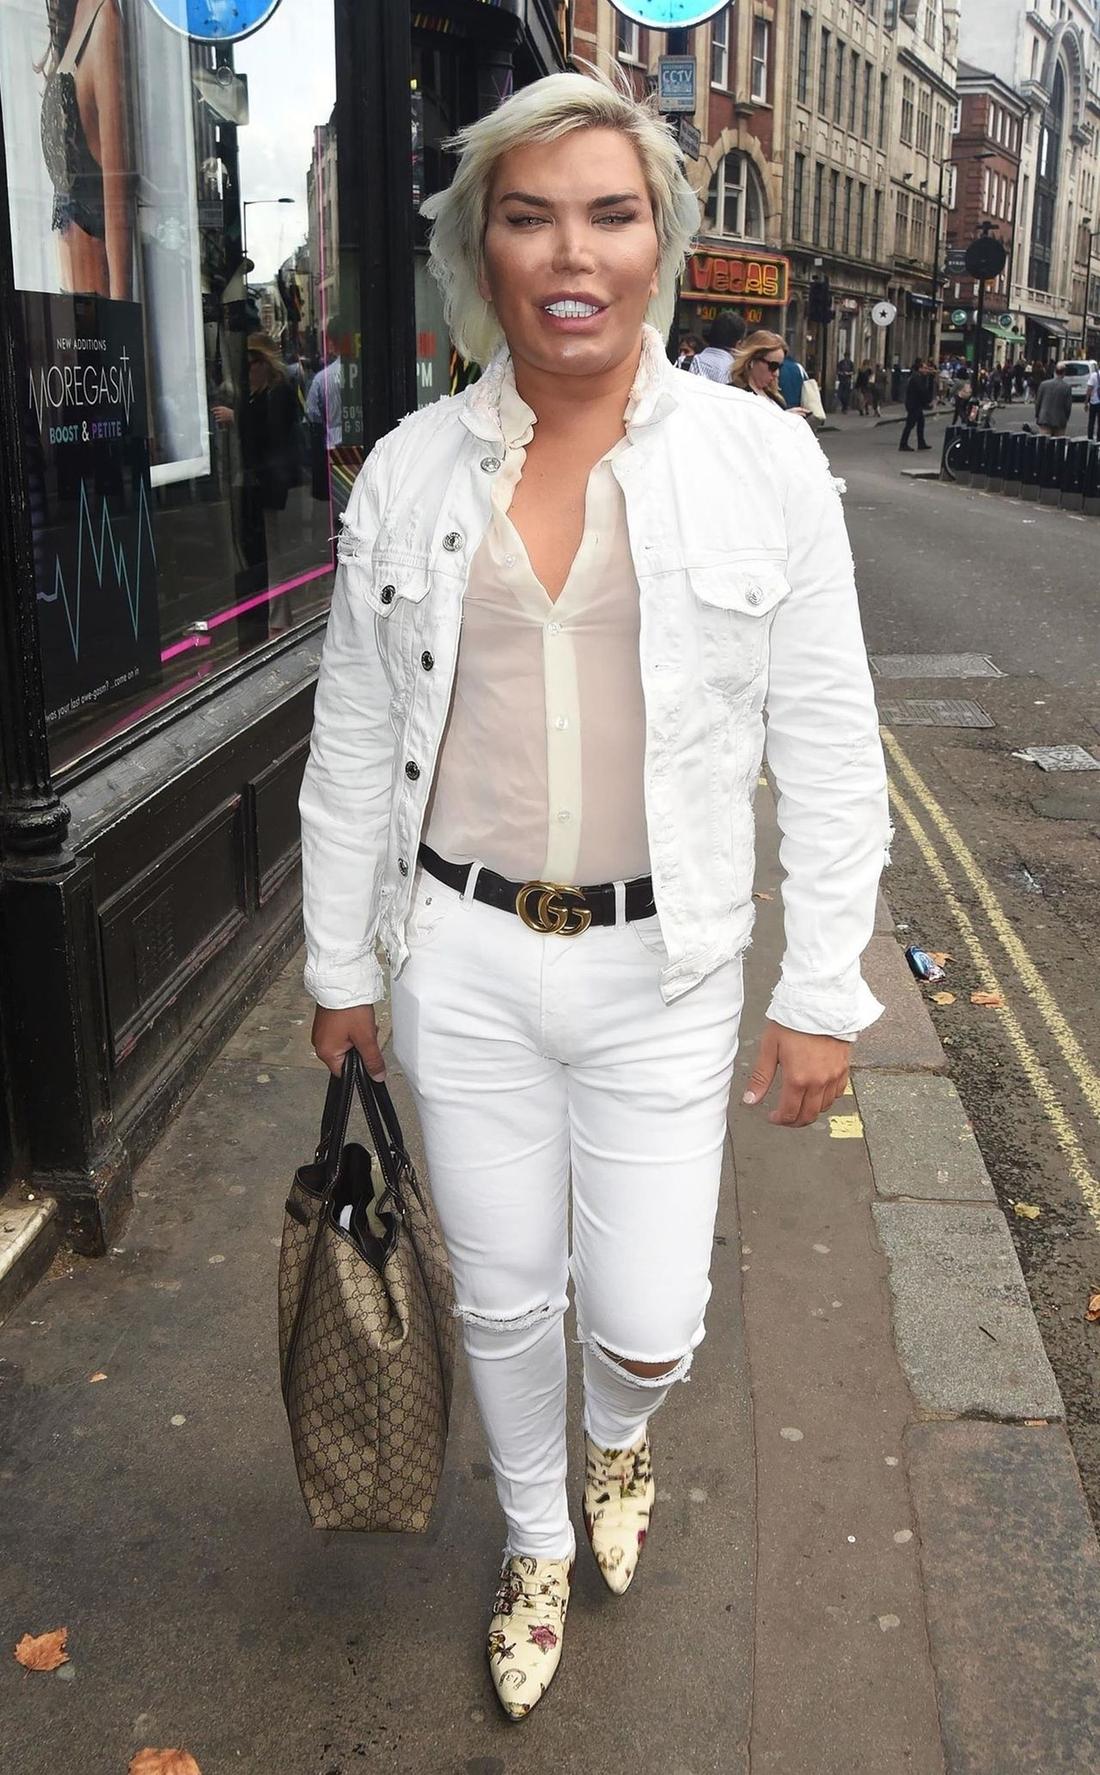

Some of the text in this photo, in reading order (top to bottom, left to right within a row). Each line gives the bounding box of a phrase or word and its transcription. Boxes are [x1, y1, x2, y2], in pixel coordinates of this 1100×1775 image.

[662, 70, 692, 82] CCTV
[692, 255, 778, 296] VEGAS
[56, 338, 107, 351] NEW ADDITIONS
[29, 364, 135, 434] MOREGASM
[50, 420, 122, 444] BOOST & PETITE
[57, 703, 70, 719] your
